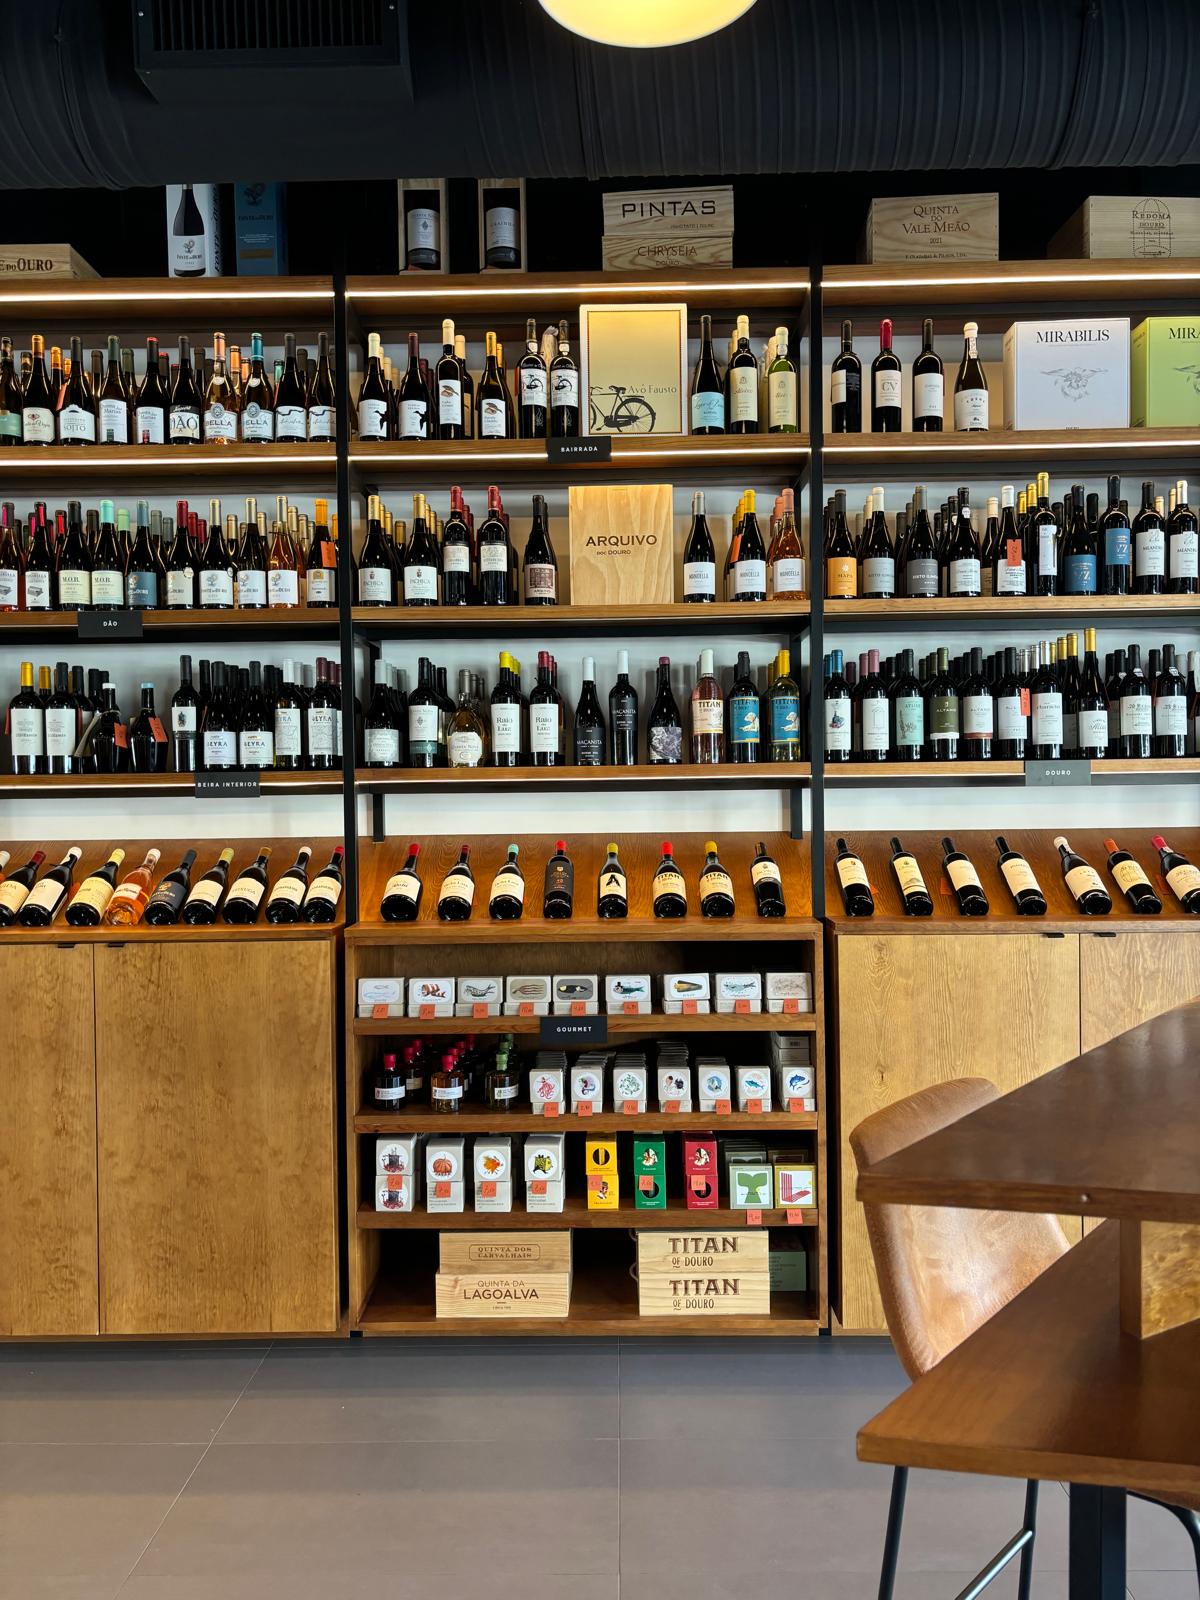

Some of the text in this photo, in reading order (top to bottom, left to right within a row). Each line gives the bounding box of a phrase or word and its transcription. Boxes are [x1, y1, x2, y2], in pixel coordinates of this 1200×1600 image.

[622, 200, 716, 218] PINTAS
[914, 205, 960, 218] QUINTA
[1132, 210, 1170, 219] REDOMA
[902, 221, 970, 234] VALE MEÃO
[637, 246, 698, 256] CHRYSEIA
[17, 258, 53, 271] OURO
[1036, 328, 1110, 343] MIRABILIS
[628, 384, 678, 394] Avó Fausto
[586, 534, 657, 547] ARQUIVO
[606, 874, 620, 886] A
[668, 1236, 739, 1254] TITAN
[672, 1256, 714, 1268] OF DOURO
[669, 1278, 740, 1296] TITAN
[463, 1288, 539, 1300] LAGOALVA
[673, 1299, 714, 1310] OF DOURO
